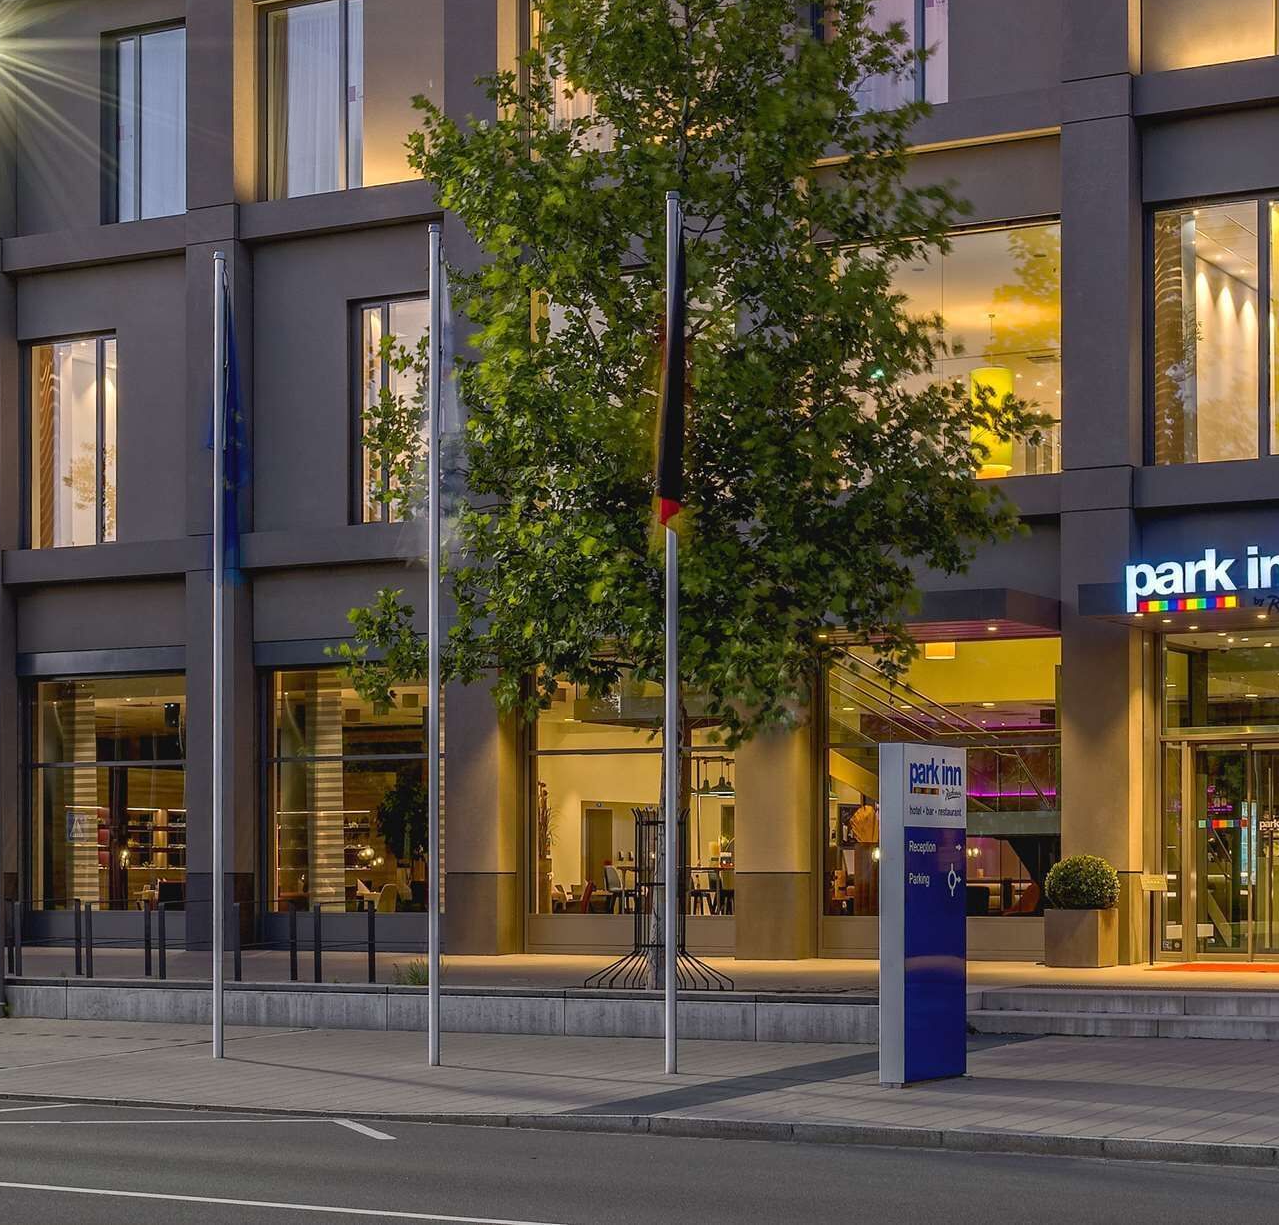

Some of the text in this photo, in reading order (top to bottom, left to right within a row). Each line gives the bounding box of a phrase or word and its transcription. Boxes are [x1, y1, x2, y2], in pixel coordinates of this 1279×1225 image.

[1126, 549, 1237, 613] park
[1254, 596, 1265, 608] by
[910, 757, 940, 794] park
[942, 758, 962, 786] inn
[910, 805, 962, 817] hotel bar restaurant
[1260, 819, 1279, 831] park
[909, 840, 937, 855] Reception
[909, 872, 930, 888] Parking
